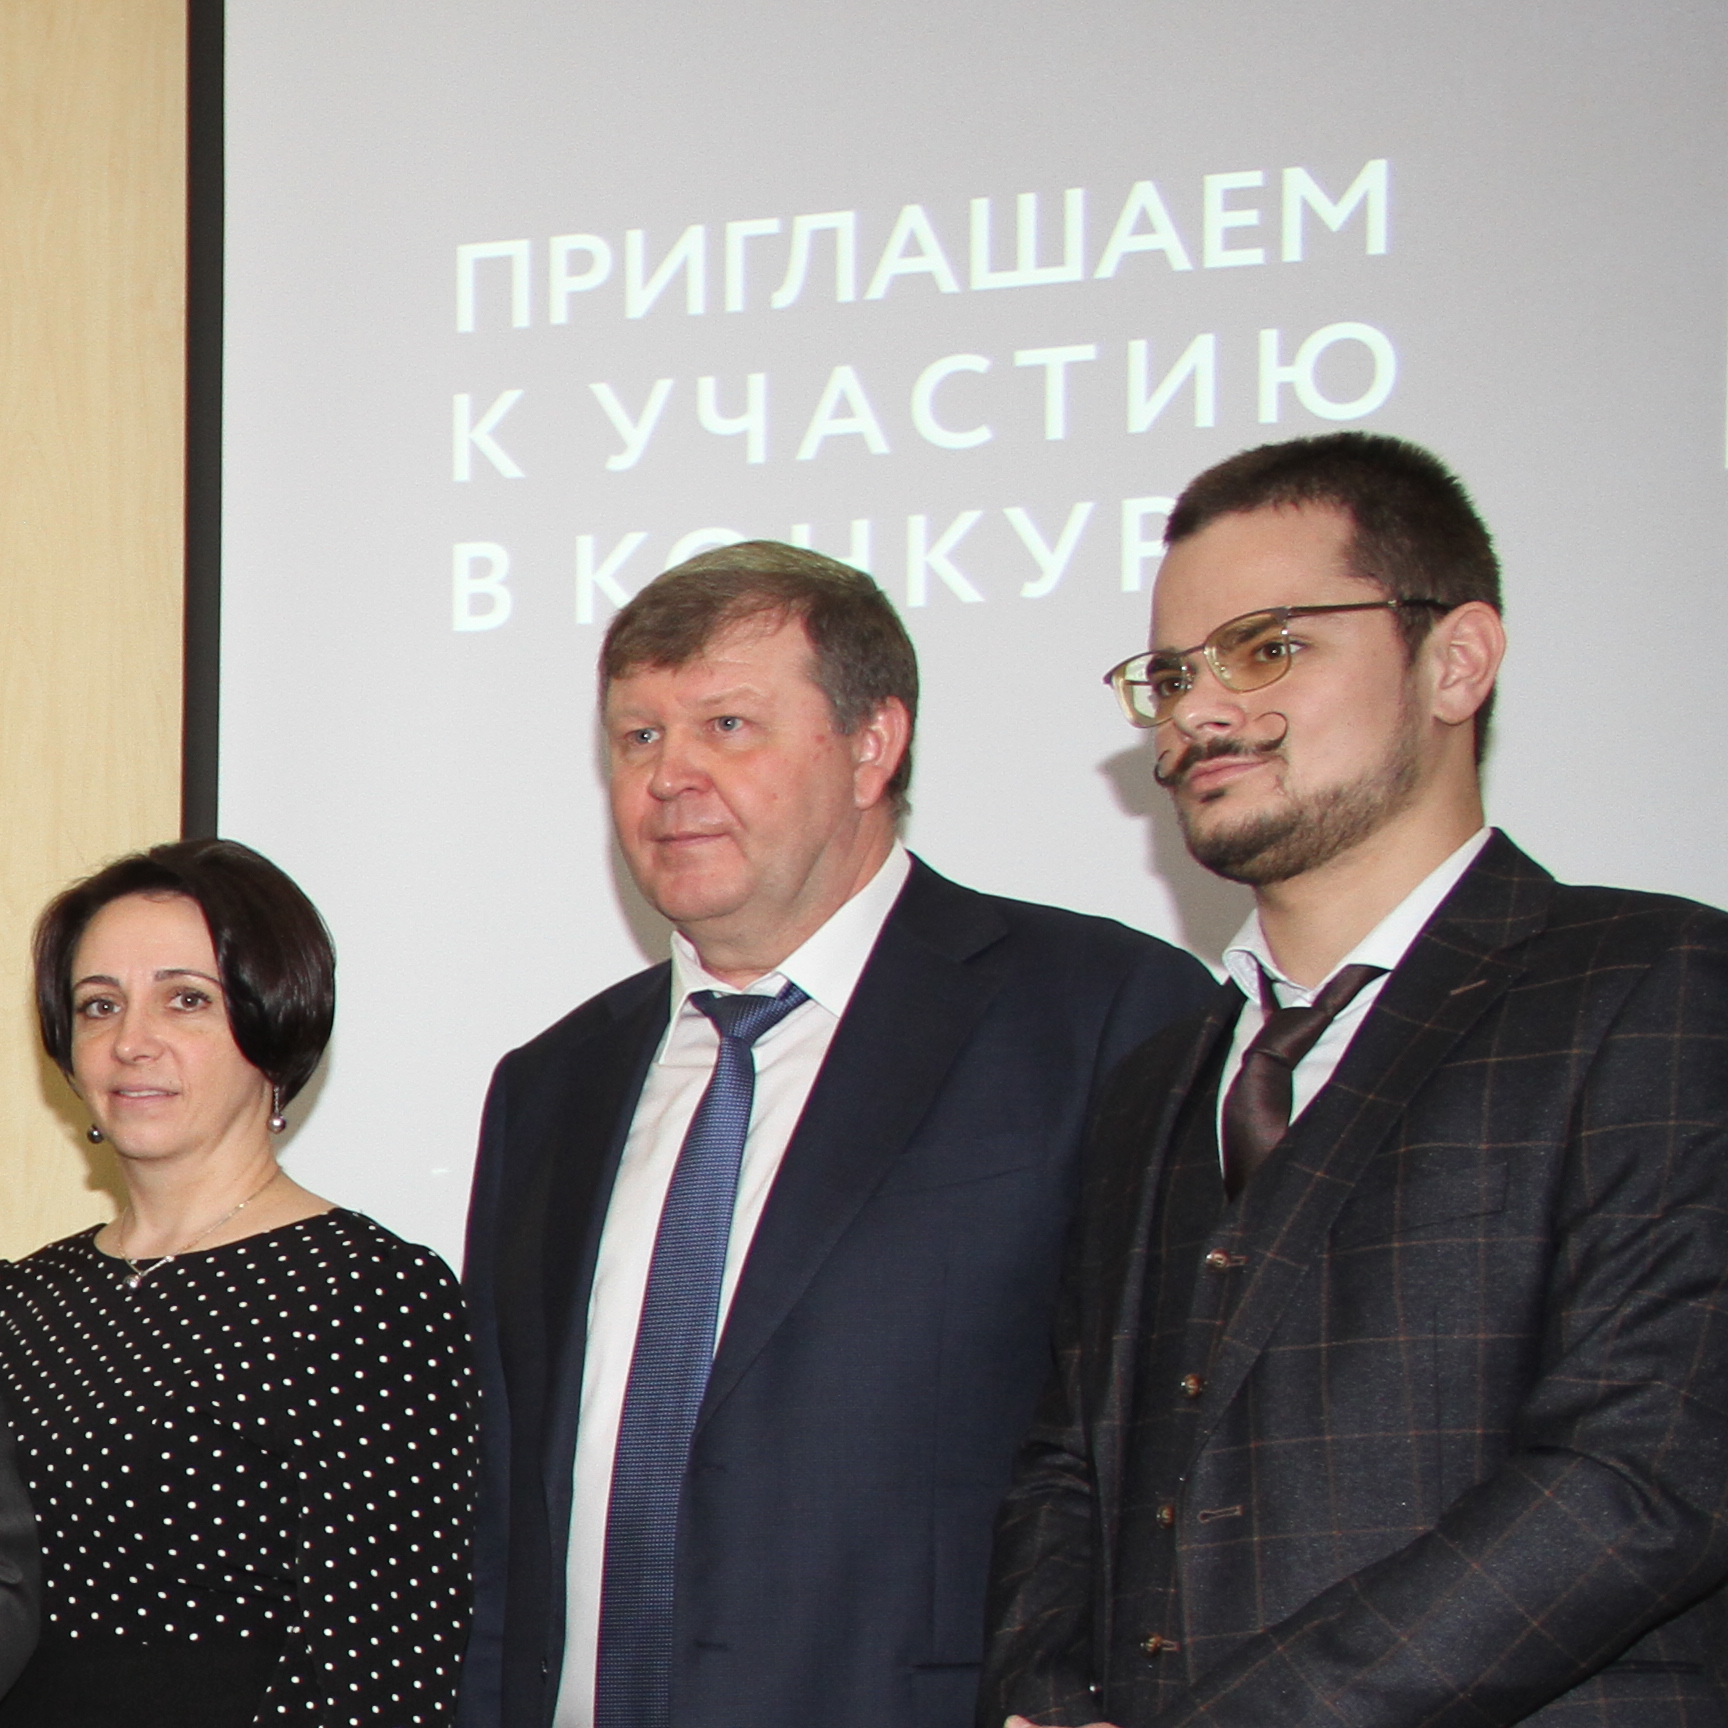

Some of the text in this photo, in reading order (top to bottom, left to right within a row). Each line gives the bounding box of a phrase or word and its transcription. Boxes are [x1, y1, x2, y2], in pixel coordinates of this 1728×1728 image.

[454, 157, 1391, 334] ПРИГЛАШАЕМ
[452, 320, 1399, 483] К УЧАСТИЮ
[450, 494, 1179, 632] В ККУР
